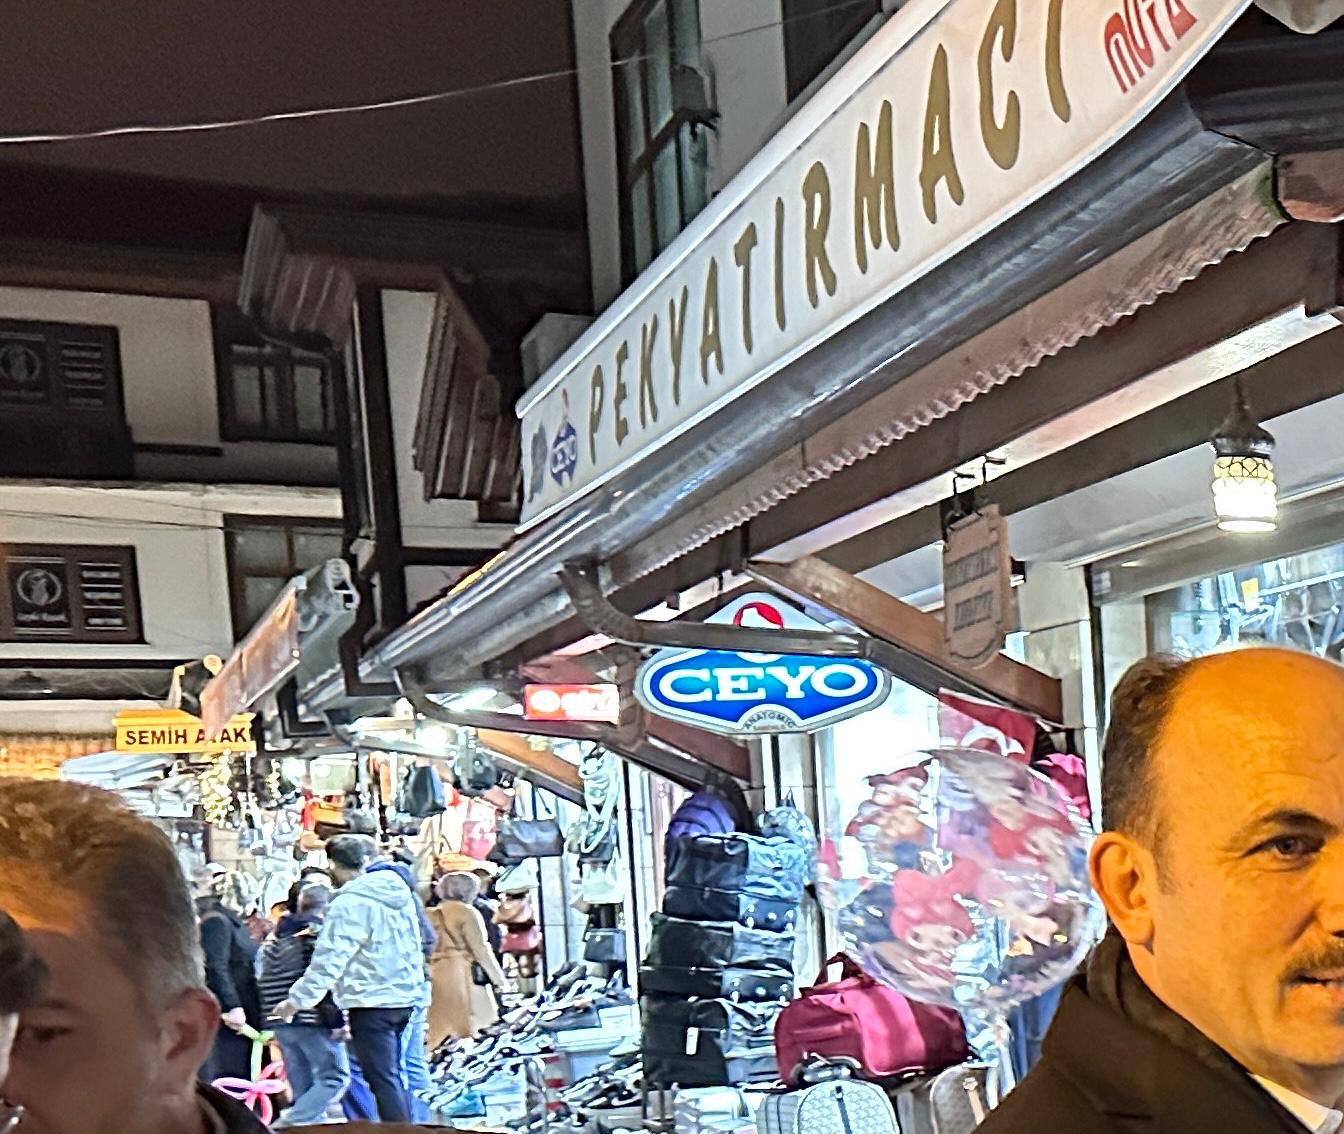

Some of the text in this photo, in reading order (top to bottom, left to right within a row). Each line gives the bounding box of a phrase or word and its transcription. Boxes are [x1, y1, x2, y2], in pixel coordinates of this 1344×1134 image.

[589, 0, 1071, 465] PEKYATIRMACI
[658, 663, 869, 703] CEYO
[194, 728, 247, 744] AAK
